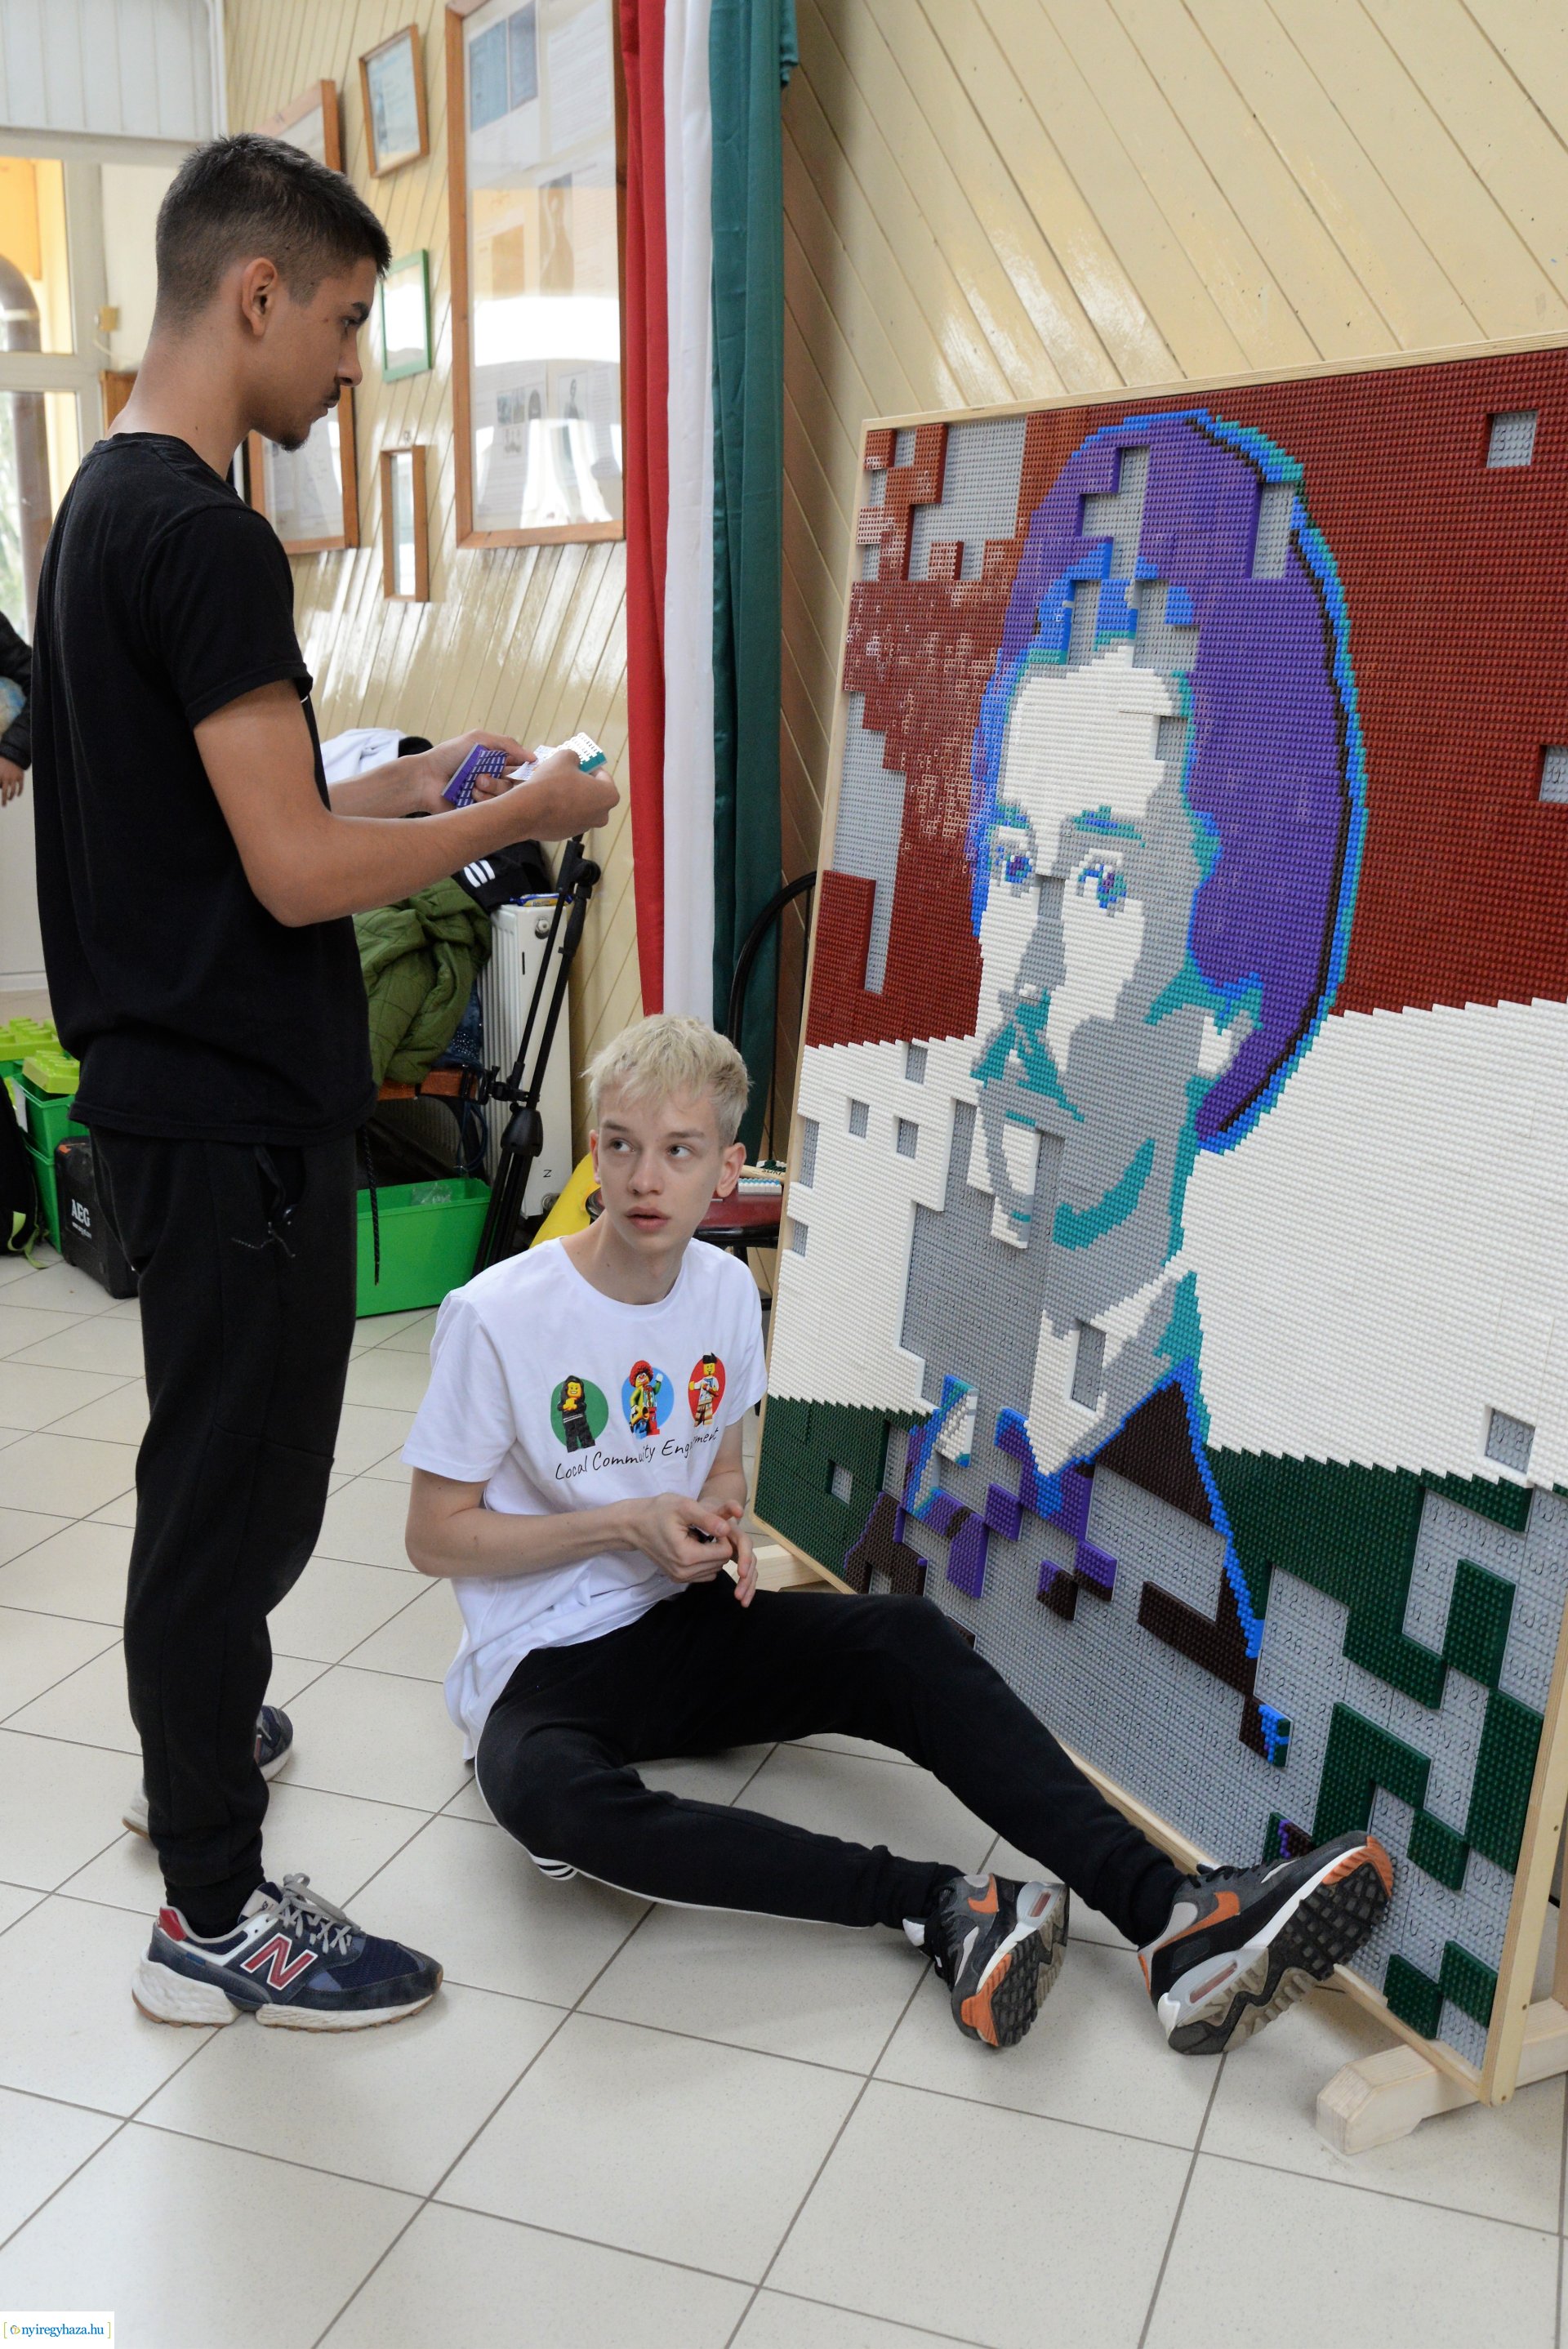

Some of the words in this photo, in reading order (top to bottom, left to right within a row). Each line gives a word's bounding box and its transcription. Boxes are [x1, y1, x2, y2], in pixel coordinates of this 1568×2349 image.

[71, 1198, 91, 1228] AEG
[555, 1455, 588, 1480] Local
[240, 1932, 318, 1991] N
